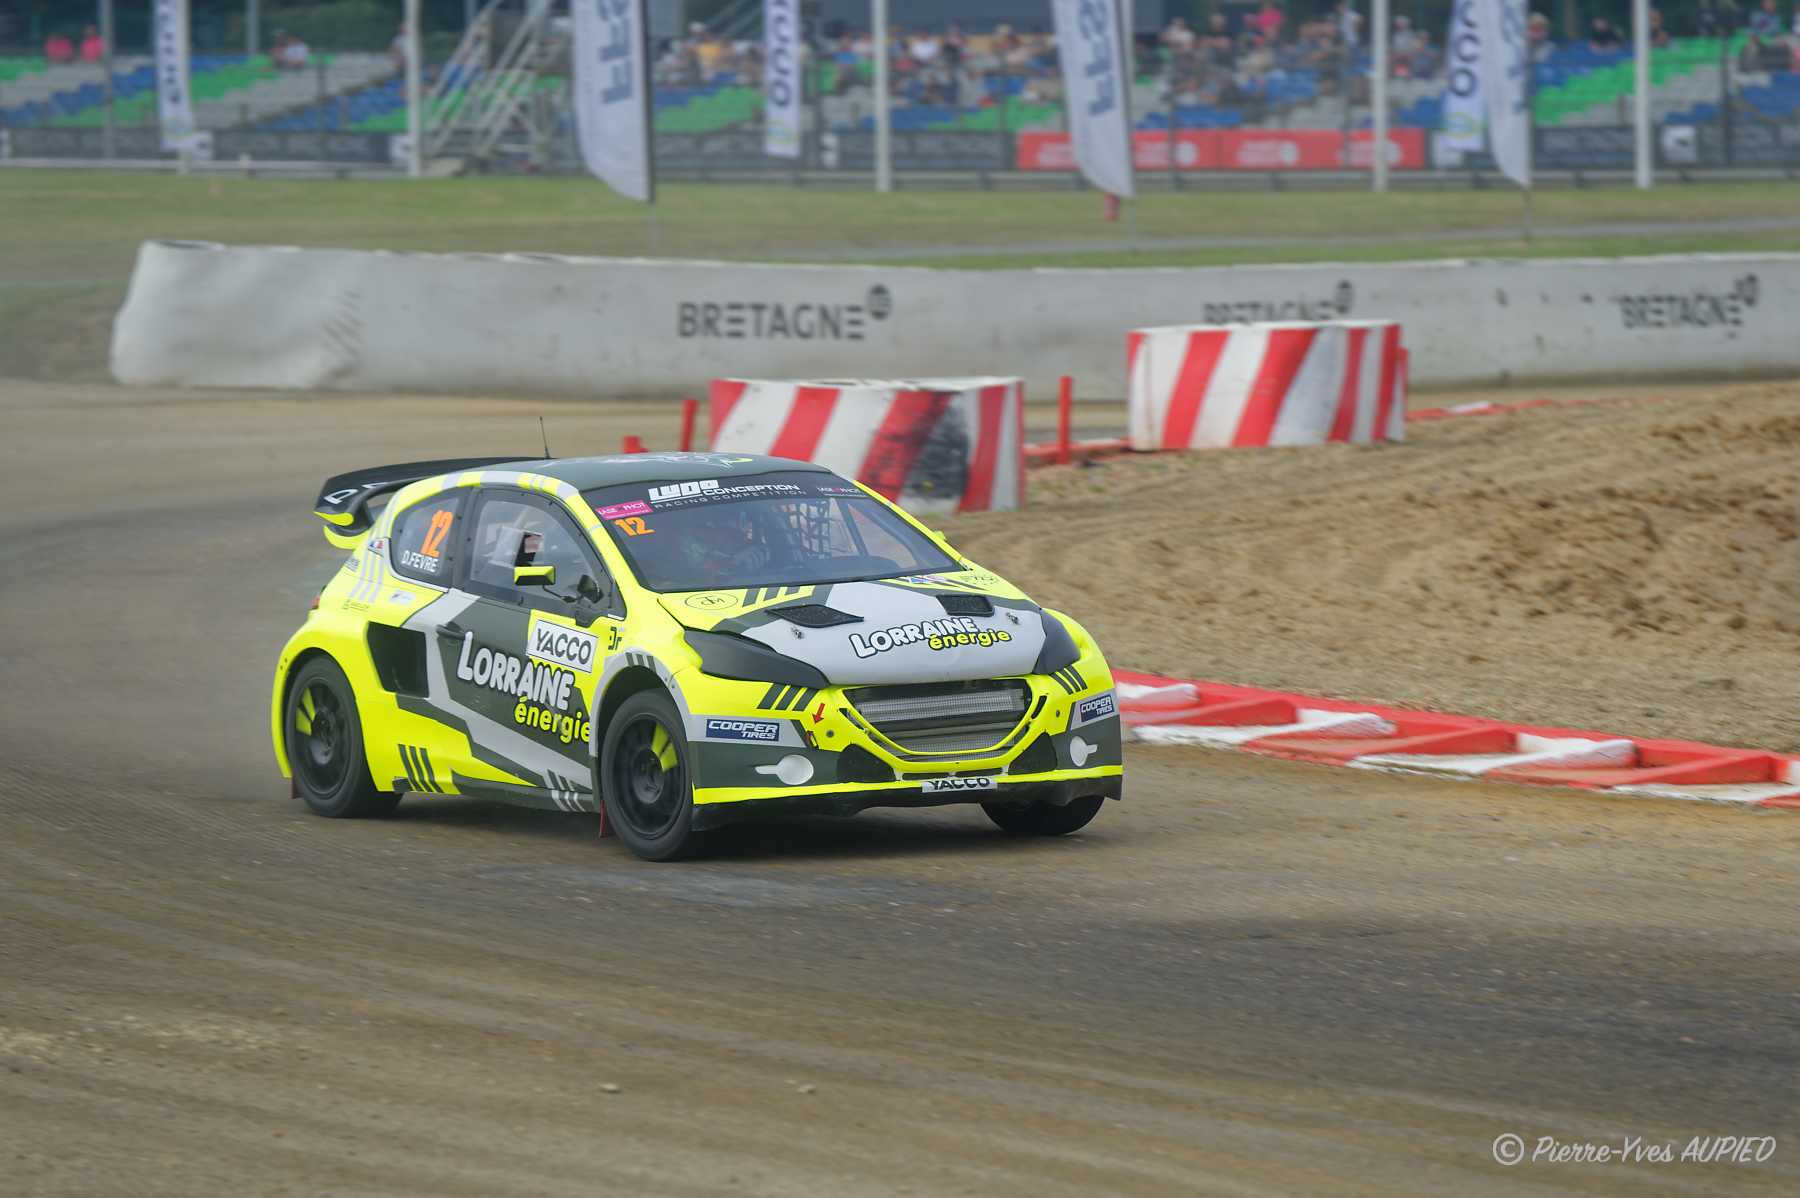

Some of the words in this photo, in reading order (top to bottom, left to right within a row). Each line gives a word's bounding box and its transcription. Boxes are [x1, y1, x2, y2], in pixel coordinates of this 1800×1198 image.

[679, 302, 865, 339] BRETAGNE
[1619, 293, 1744, 328] BRETAGNE
[648, 480, 719, 501] LUDO
[702, 484, 800, 496] CONCEPTION
[654, 497, 708, 508] RACING
[711, 489, 807, 501] COMPETITION
[420, 510, 453, 558] 12
[614, 516, 656, 537] 12
[401, 550, 440, 573] D.FEVRE
[536, 628, 592, 665] YACCO
[849, 617, 981, 658] LORRAINE
[928, 629, 1012, 650] énergie
[457, 631, 575, 711] LORRAINE
[1081, 697, 1111, 713] COOPER
[514, 696, 591, 744] énergie
[708, 720, 778, 733] COOPER
[741, 731, 776, 740] TIRES
[928, 777, 992, 790] YACCO
